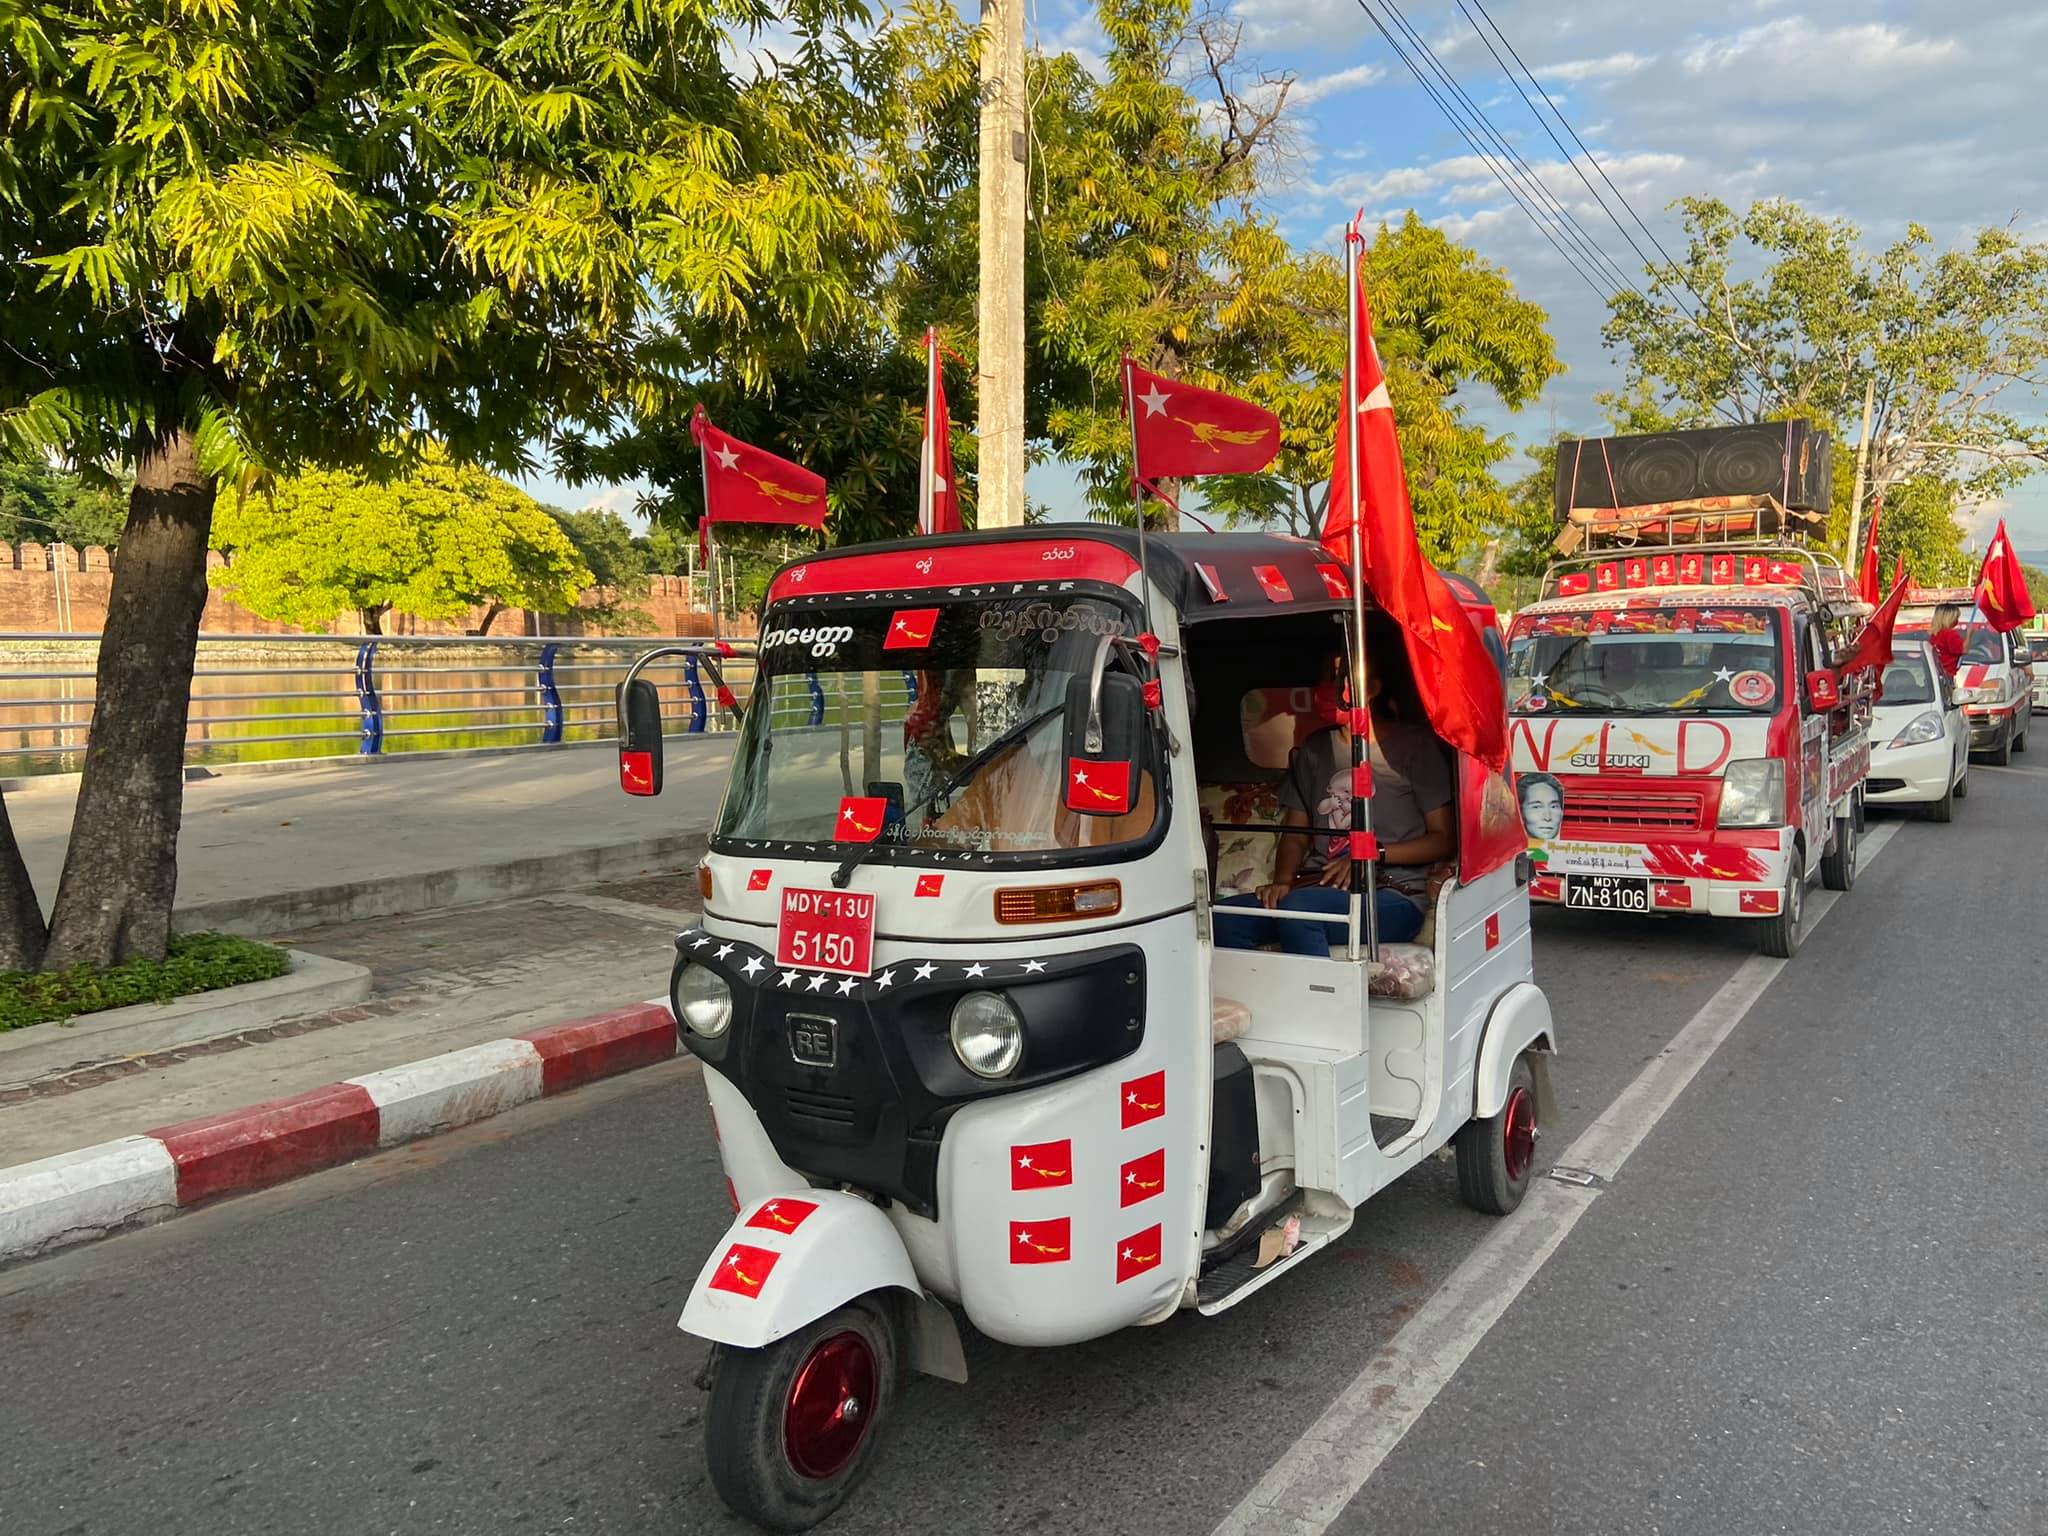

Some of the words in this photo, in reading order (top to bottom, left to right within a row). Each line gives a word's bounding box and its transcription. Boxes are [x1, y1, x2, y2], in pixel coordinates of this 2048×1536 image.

[1571, 753, 1650, 768] SUZUKI
[1593, 877, 1620, 888] MDY
[786, 892, 870, 919] MDY-13U
[1571, 886, 1645, 909] 7N-8106
[792, 930, 854, 966] 5150
[795, 1030, 830, 1056] RE
